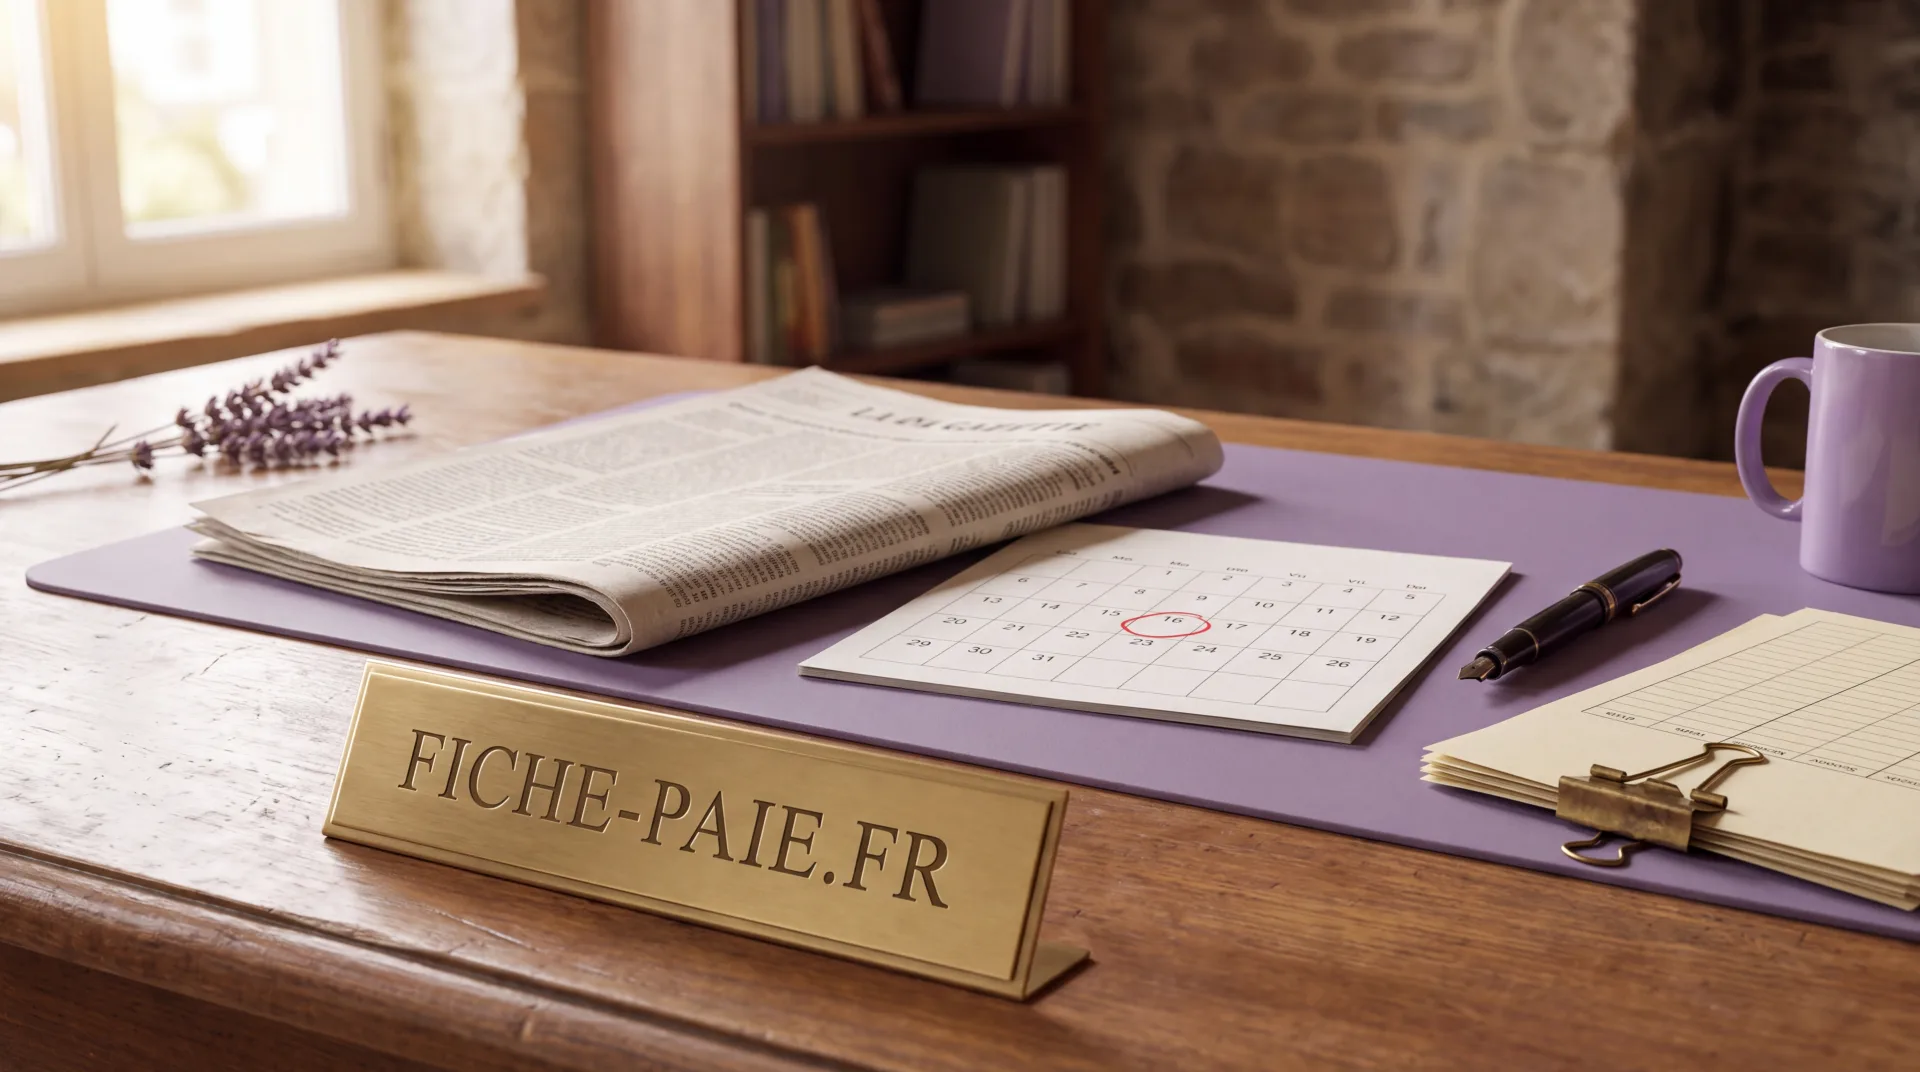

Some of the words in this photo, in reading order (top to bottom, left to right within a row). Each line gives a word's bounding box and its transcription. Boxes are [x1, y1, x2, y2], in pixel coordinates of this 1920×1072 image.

[982, 596, 1003, 604] 13
[1041, 602, 1061, 610] 14
[1101, 609, 1122, 617] 15
[1162, 614, 1185, 625] 16
[1290, 629, 1312, 638] 18
[1356, 636, 1377, 644] 19
[1254, 601, 1275, 609] 10
[1317, 607, 1335, 615] 11
[906, 639, 932, 648] 29
[967, 646, 993, 655] 30
[1031, 654, 1055, 662] 31
[942, 617, 968, 625] 20
[1002, 623, 1026, 632] 21
[1064, 631, 1090, 639] 22
[1129, 637, 1156, 647] 23
[1192, 645, 1218, 654] 24
[1258, 652, 1282, 661] 25
[1325, 659, 1351, 668] 26
[397, 728, 950, 909] FICHE-PAIE.FR
